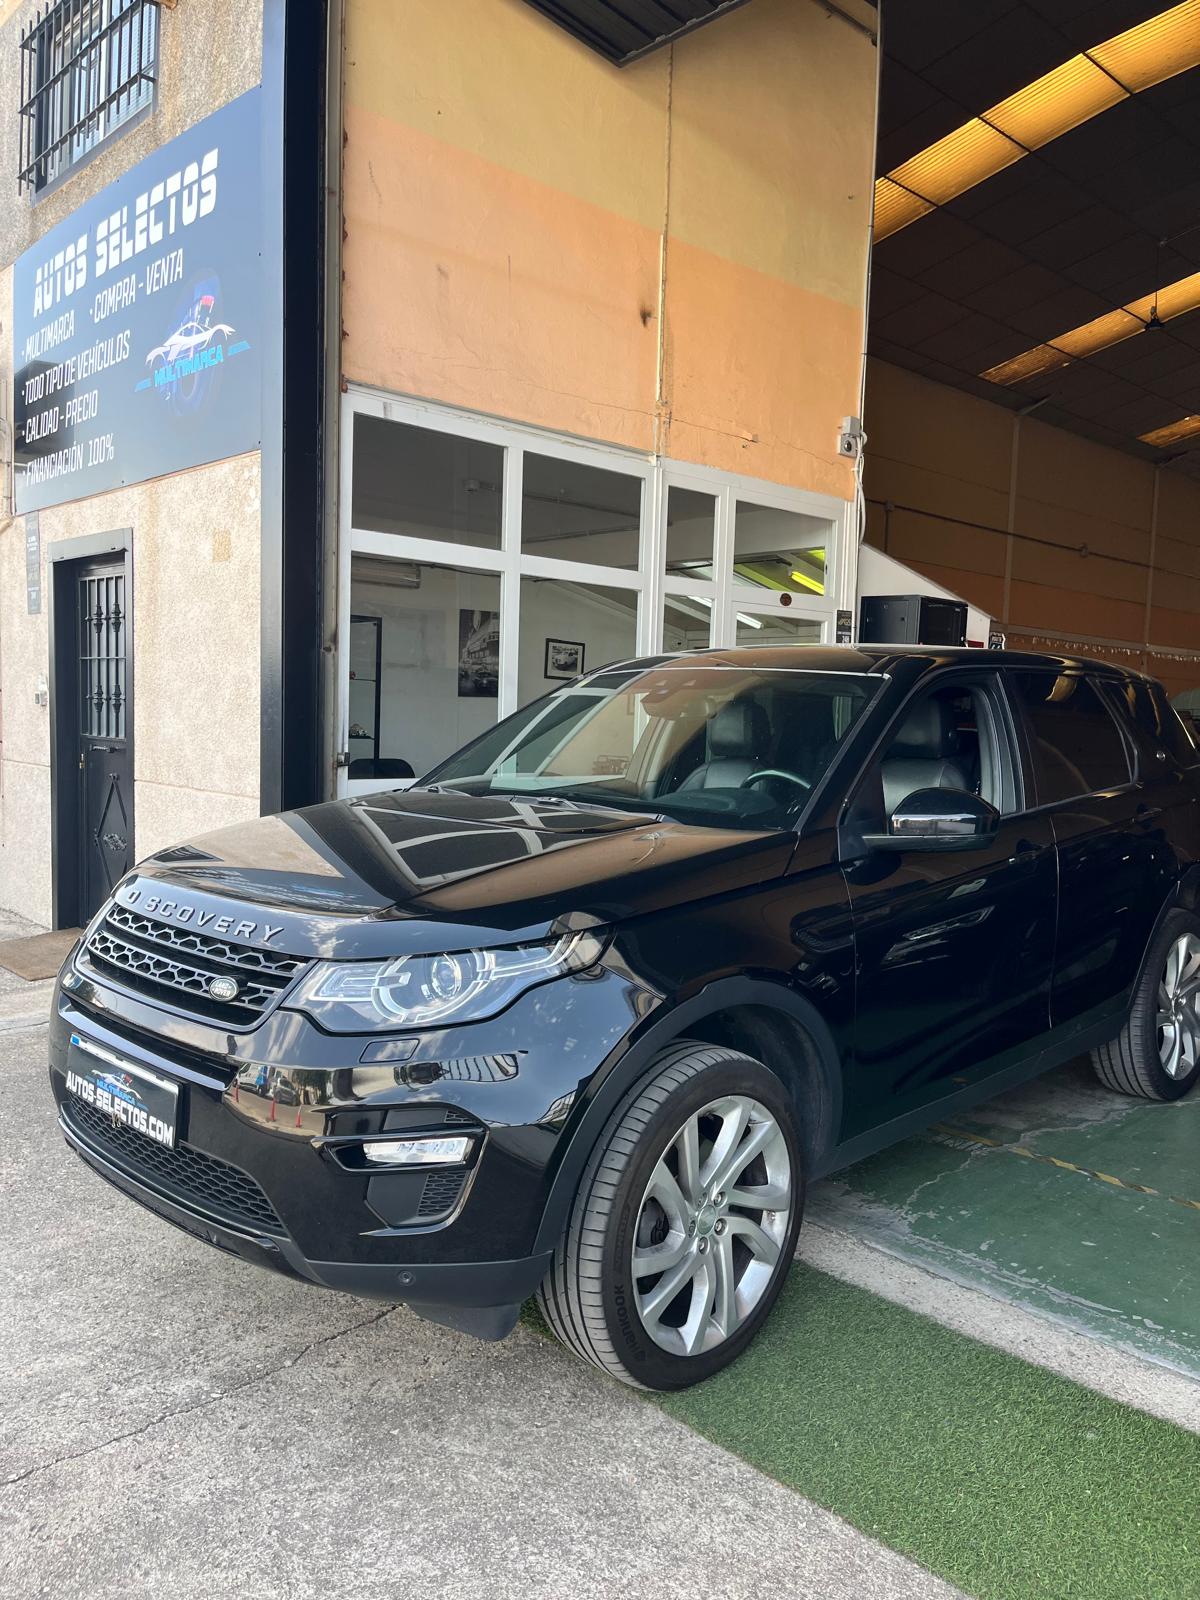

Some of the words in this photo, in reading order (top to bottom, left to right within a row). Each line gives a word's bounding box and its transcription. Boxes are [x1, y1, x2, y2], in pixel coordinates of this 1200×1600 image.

[33, 233, 88, 318] AUTOS
[95, 148, 219, 278] SELECTOS
[94, 273, 136, 323] COMPRA
[146, 248, 183, 296] VENTA
[25, 309, 75, 362] MULTIMARCA
[25, 373, 45, 406] TODO
[45, 362, 64, 396] TIPO
[64, 356, 76, 387] DE
[76, 329, 131, 381] VEHÍCULOS
[154, 344, 224, 387] MULTIMARCA
[25, 406, 60, 444] CALIDAD
[65, 390, 99, 428] PRECIO
[26, 440, 84, 487] FINANCIACIÓN
[88, 433, 115, 467] 100%
[126, 889, 285, 942] DSCOVERY
[65, 1070, 174, 1147] AUTOS-SELECTOS.COM
